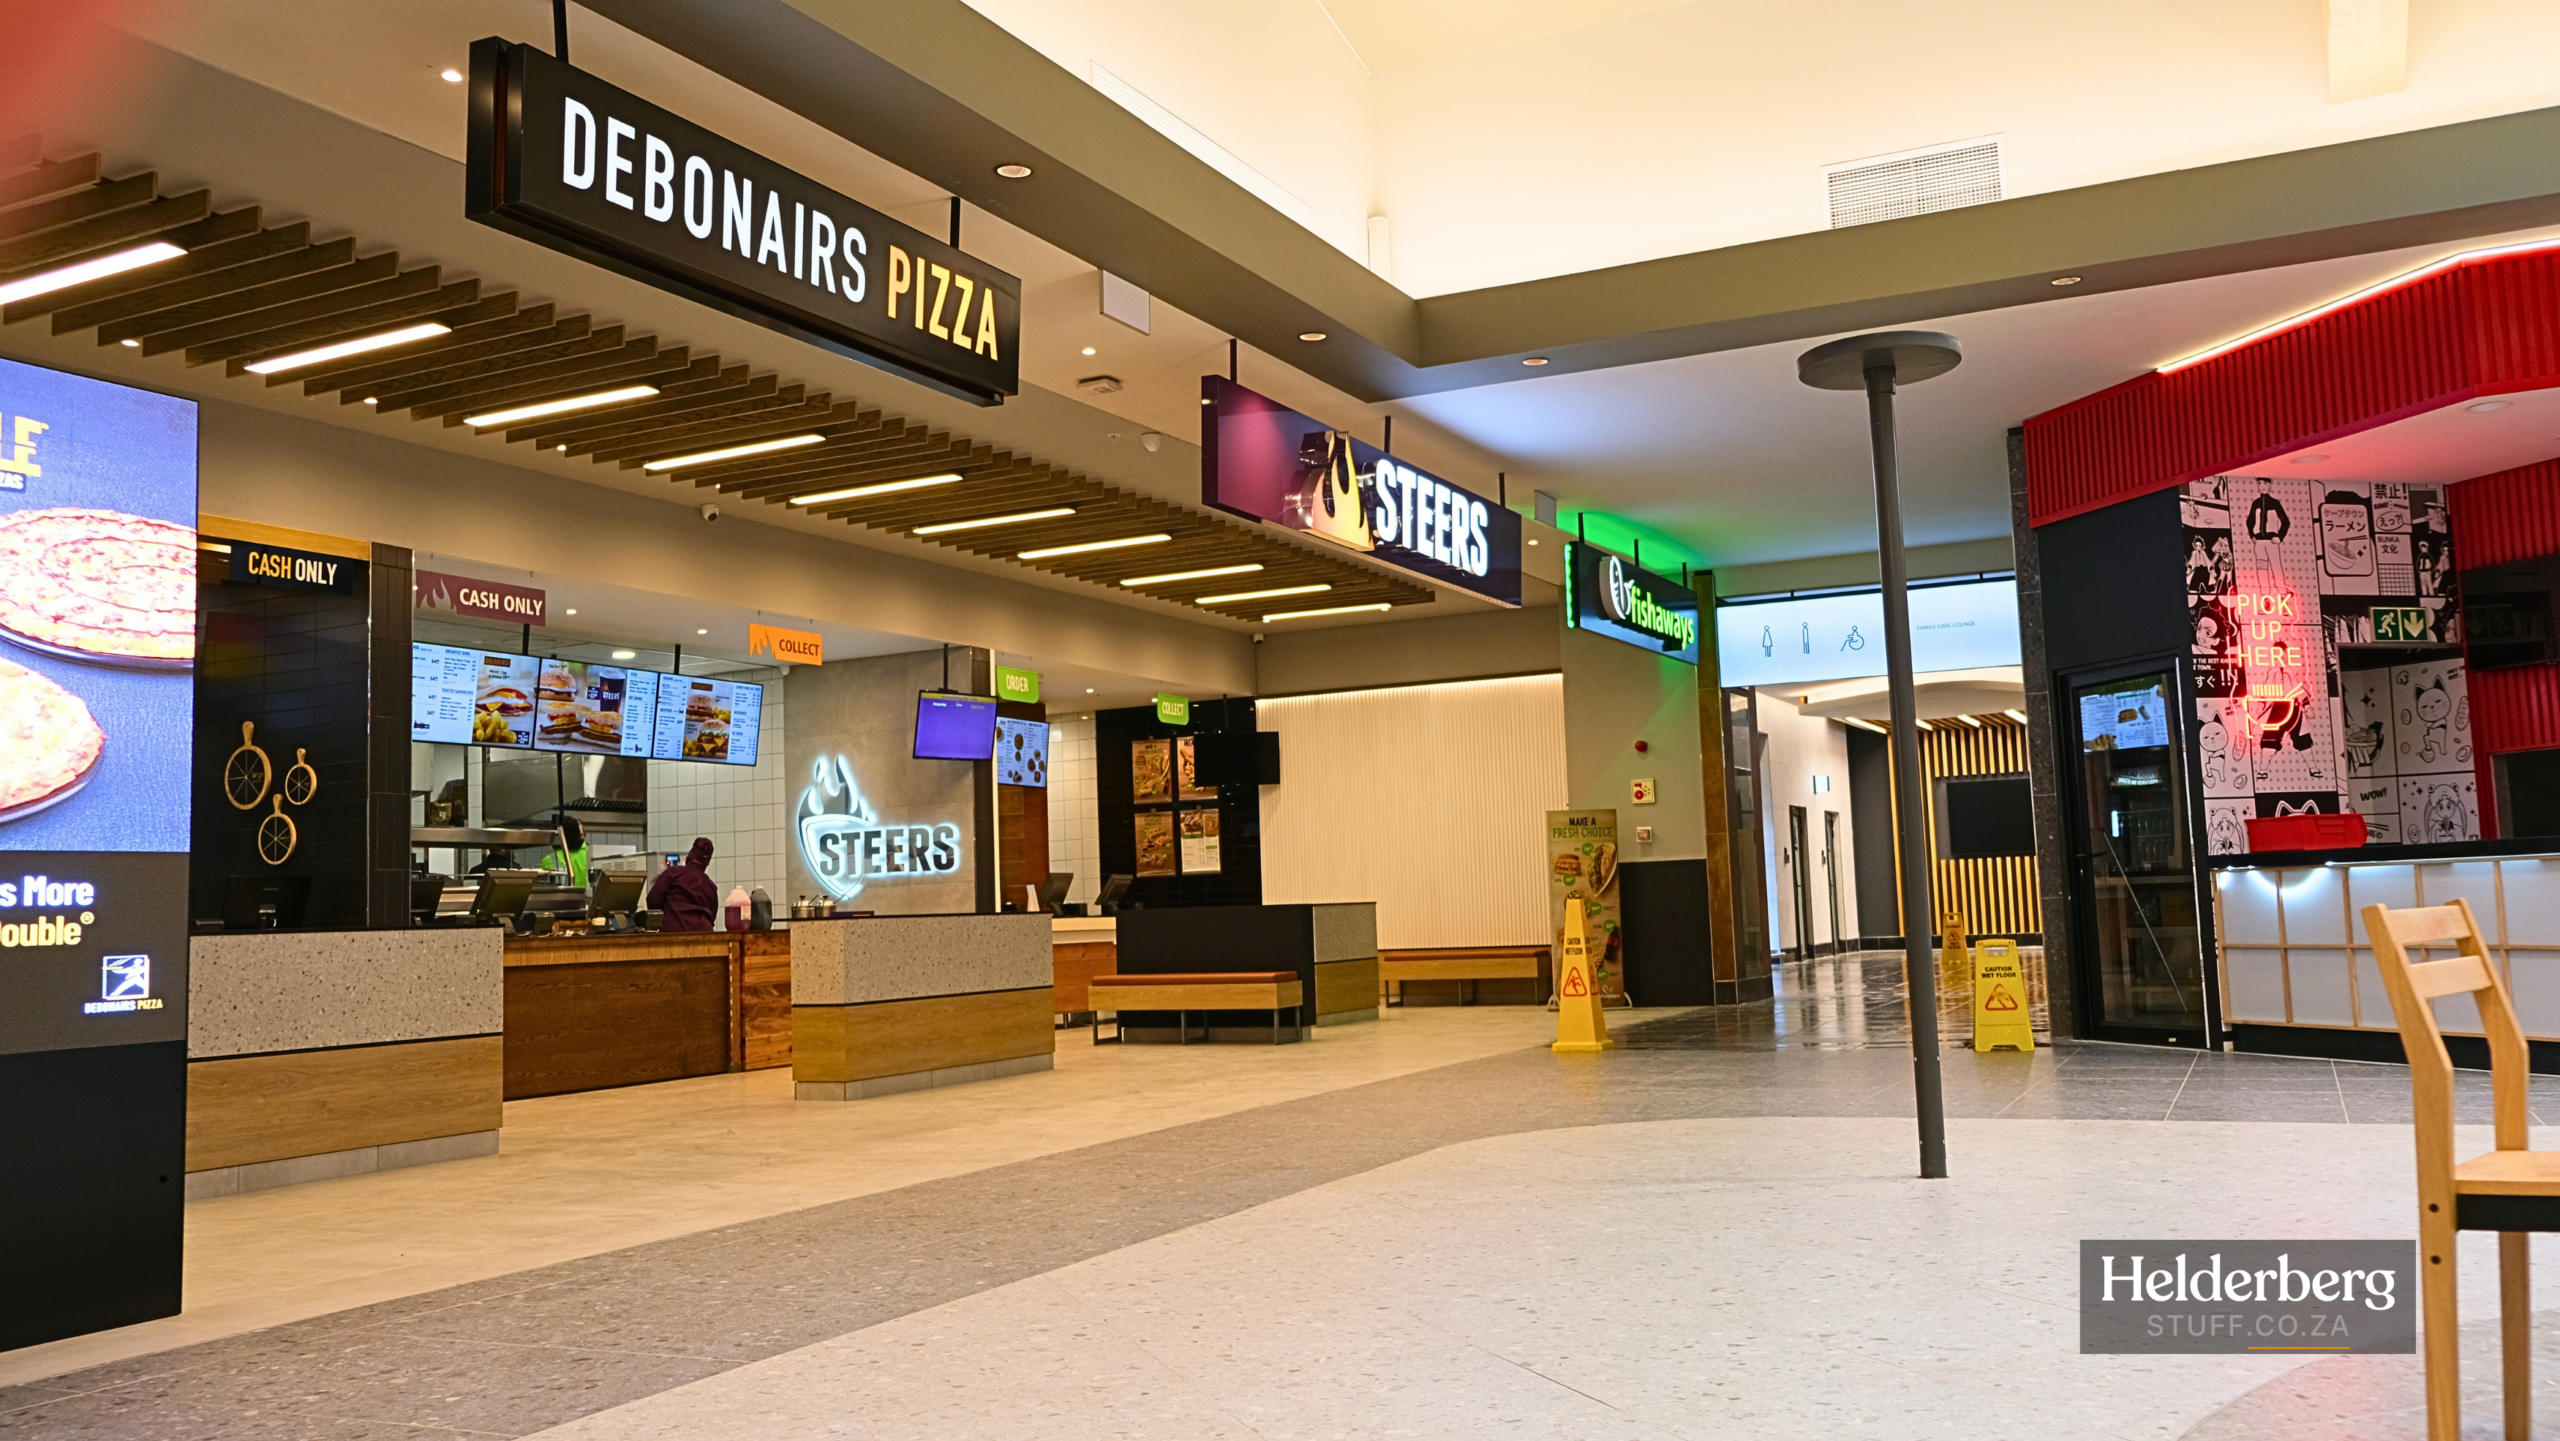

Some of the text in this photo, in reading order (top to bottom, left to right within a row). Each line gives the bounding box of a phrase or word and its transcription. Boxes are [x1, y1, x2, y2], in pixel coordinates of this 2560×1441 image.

[563, 96, 999, 362] DEBONAIRS PIZZA
[1375, 458, 1489, 578] STEERS
[2325, 520, 2367, 532] ラーメン
[2381, 544, 2398, 554] 文化
[248, 551, 338, 586] CASH ONLY
[459, 588, 543, 616] CASH ONLY
[2237, 592, 2293, 616] PICK
[1630, 585, 1695, 651] fishaways
[2251, 619, 2282, 641] UP
[779, 638, 820, 657] COLLECT
[2237, 644, 2302, 668] HERE
[485, 657, 510, 666] BREAKFAST
[1006, 674, 1030, 692] ORDER
[1162, 702, 1184, 716] COLLECT
[2360, 787, 2387, 802] WOW!
[1569, 816, 1597, 827] MAKE A
[1553, 826, 1613, 839] FRESH CHOICE
[819, 825, 955, 878] STEERS
[23, 875, 95, 906] More
[84, 999, 163, 1014] DEBONAIRS PIZZA
